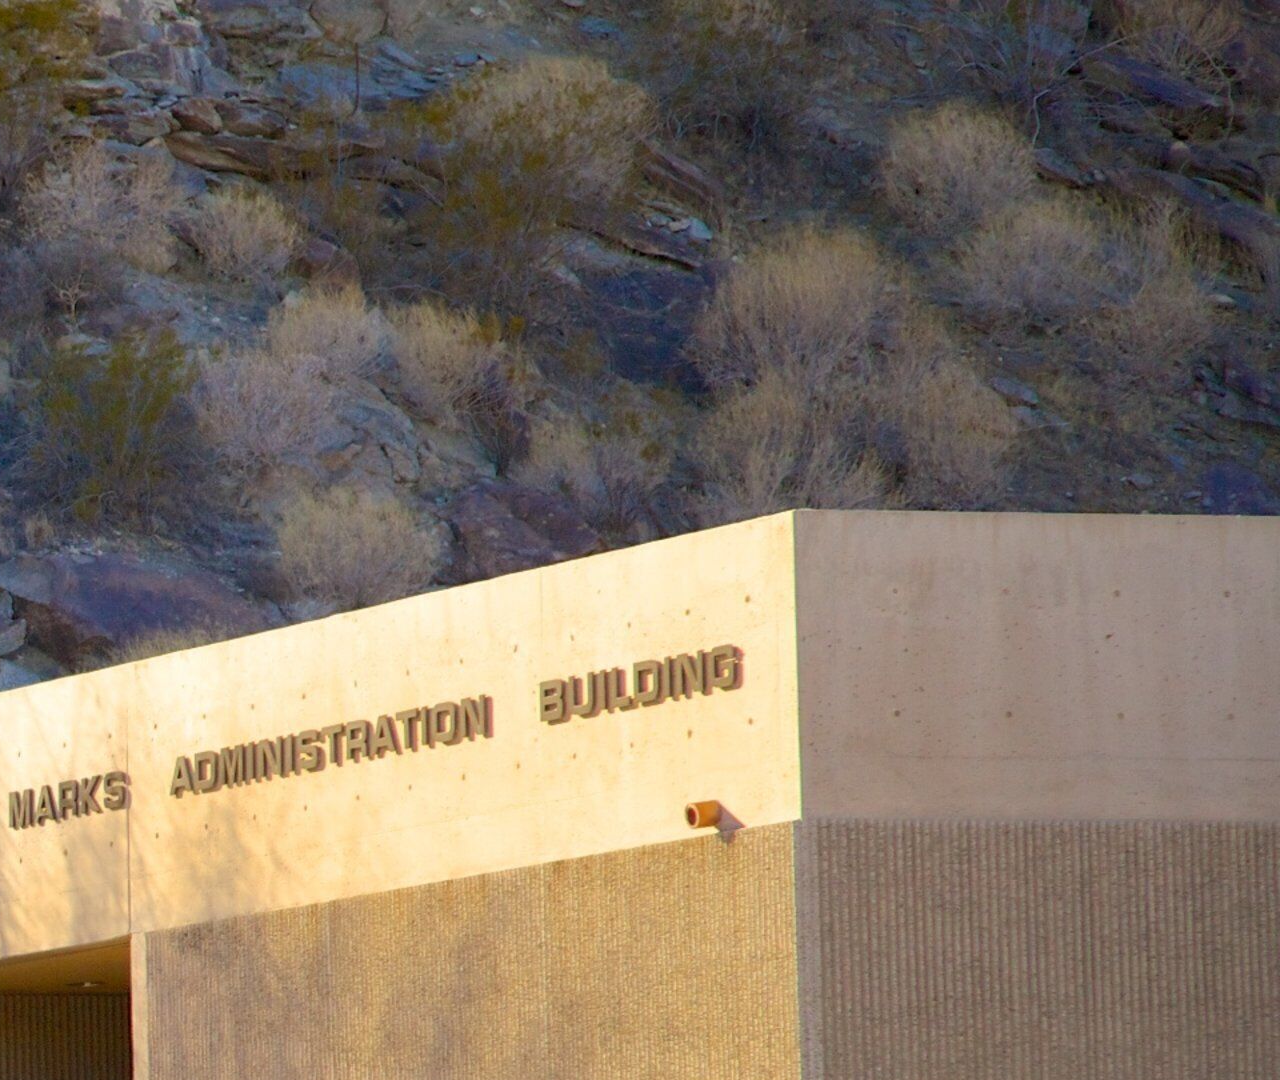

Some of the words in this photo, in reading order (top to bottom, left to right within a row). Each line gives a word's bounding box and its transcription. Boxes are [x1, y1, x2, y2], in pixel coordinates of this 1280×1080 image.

[9, 771, 132, 830] MARKS
[170, 695, 494, 799] ADMINISTRATION
[539, 644, 744, 725] BUILDING
